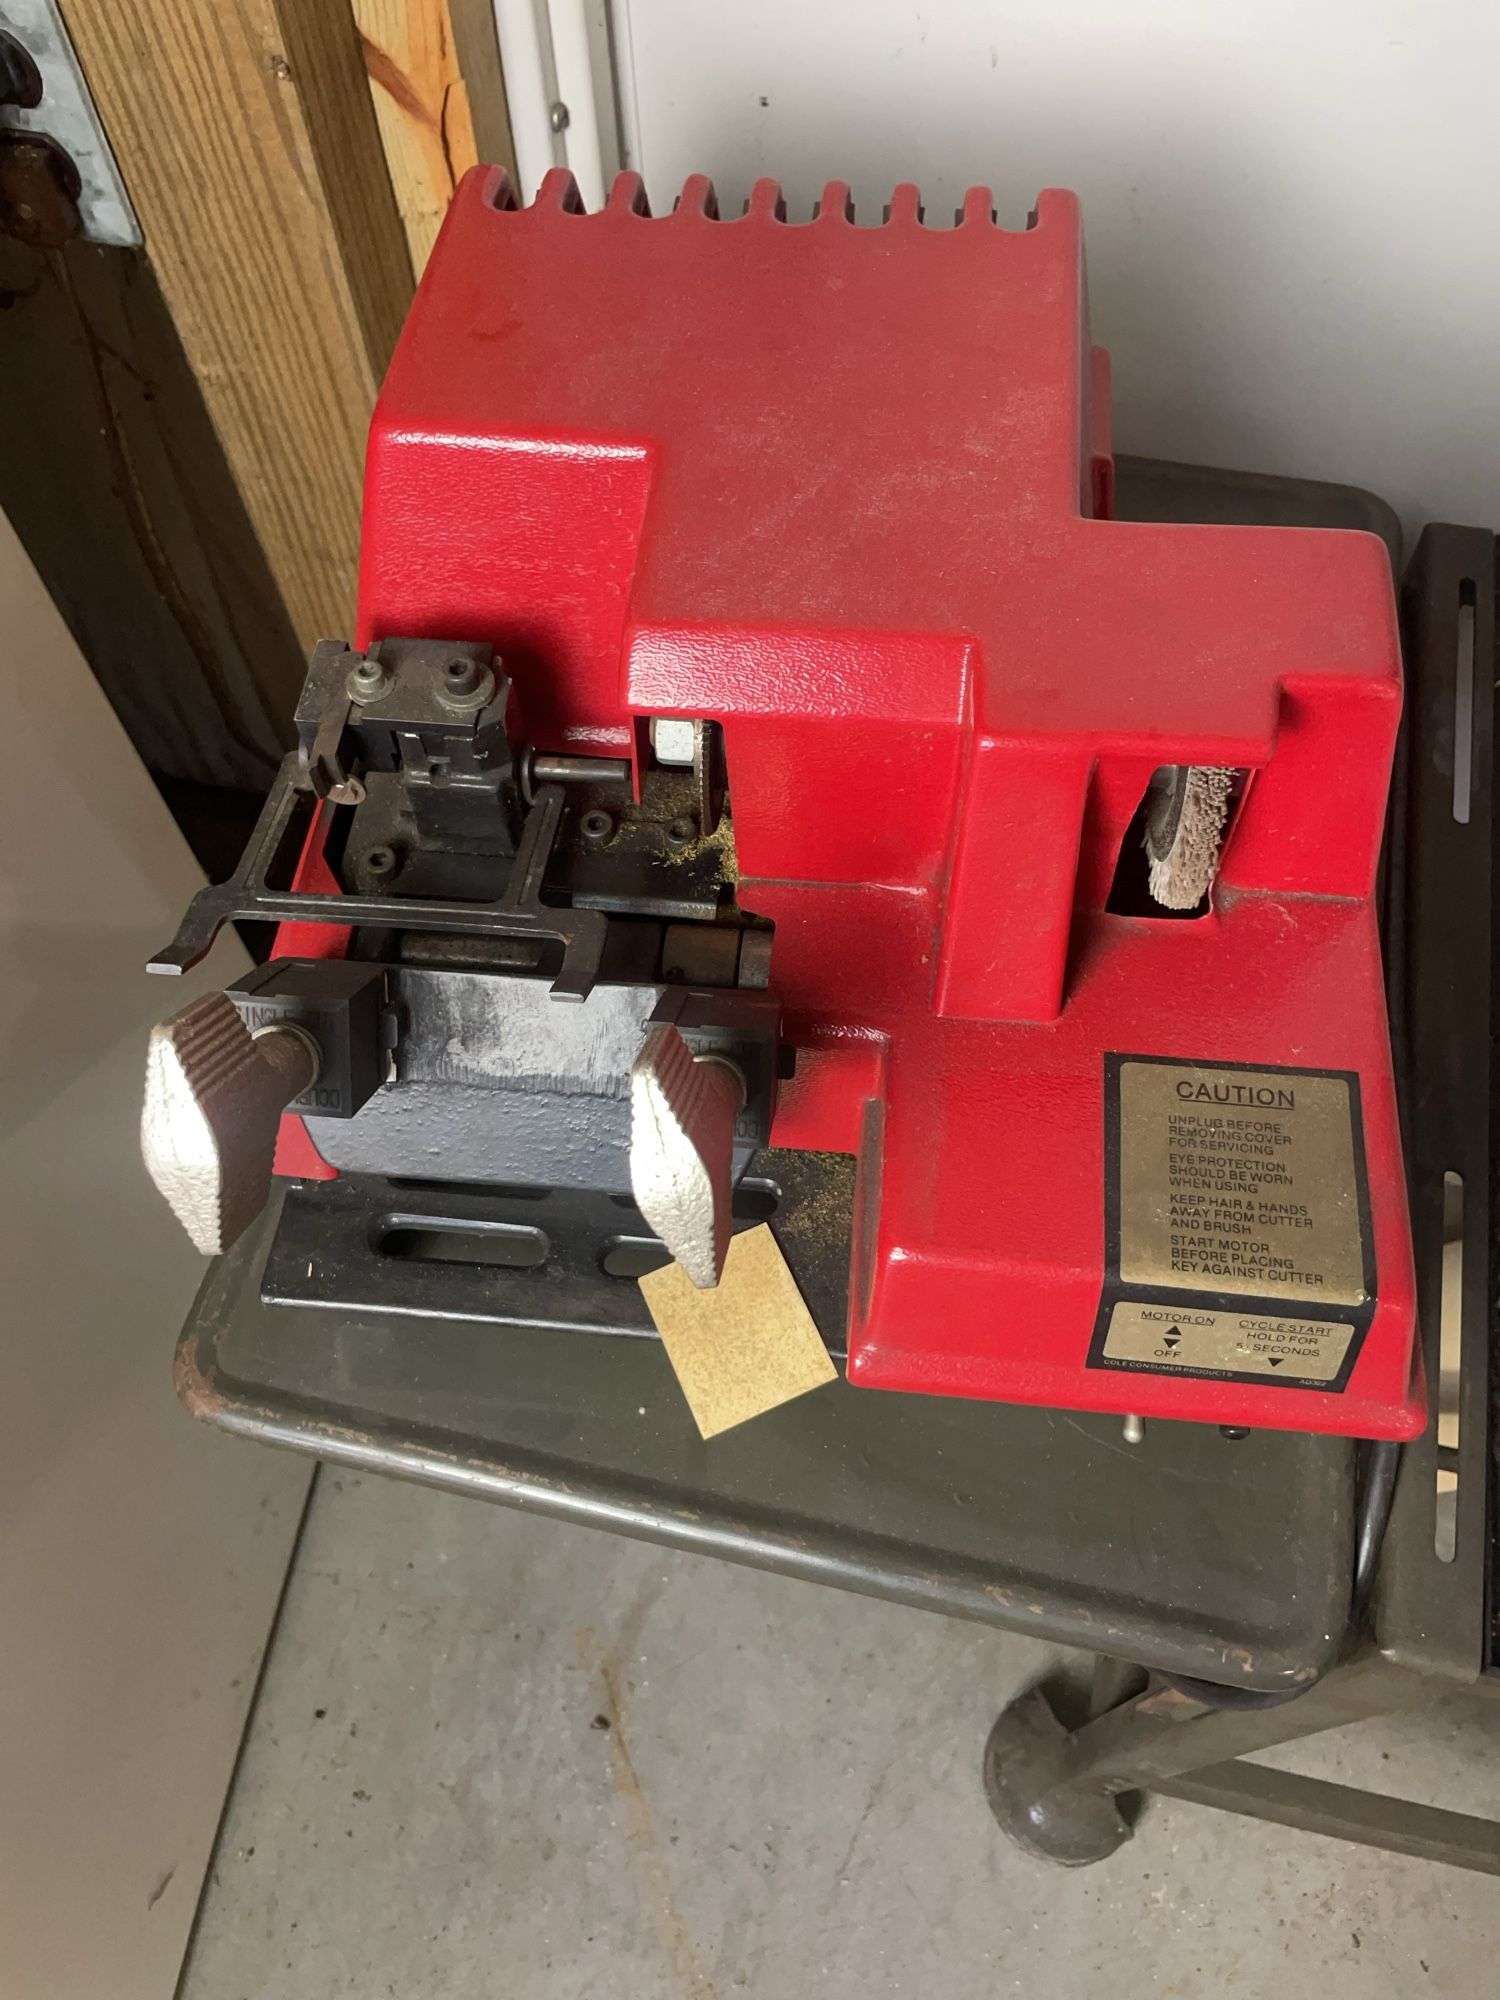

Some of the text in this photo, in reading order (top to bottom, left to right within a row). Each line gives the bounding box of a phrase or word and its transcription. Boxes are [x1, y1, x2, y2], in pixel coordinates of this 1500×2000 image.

[1176, 1081, 1295, 1107] CAUTION
[1168, 1115, 1280, 1134] UNPLUG BEFORE
[1169, 1126, 1292, 1145] REMOVING COVER
[1169, 1137, 1274, 1156] FOR SERVICING
[1169, 1153, 1285, 1173] EYE PROTECTION
[1169, 1165, 1293, 1185] SHOULD BE WORN
[1169, 1177, 1258, 1194] WHEN USING
[1170, 1194, 1307, 1216] KEEP HAIR & HANDS
[1170, 1207, 1313, 1229] AWAY FROM CUTTER
[1170, 1219, 1251, 1235] AND BRUSH
[1171, 1235, 1270, 1253] START MOTOR
[1172, 1248, 1294, 1270] BEFORE PLACING
[1172, 1261, 1323, 1285] KEY AGAINST CUTTER
[1140, 1311, 1216, 1326] MOTOR ON
[1238, 1319, 1332, 1336] CYCLE START
[1246, 1332, 1318, 1346] HOLD FOR
[1154, 1349, 1181, 1358] OFF
[1253, 1344, 1320, 1357] SECONDS
[1104, 1359, 1233, 1377] COLE CONSUMER PRODUCTS
